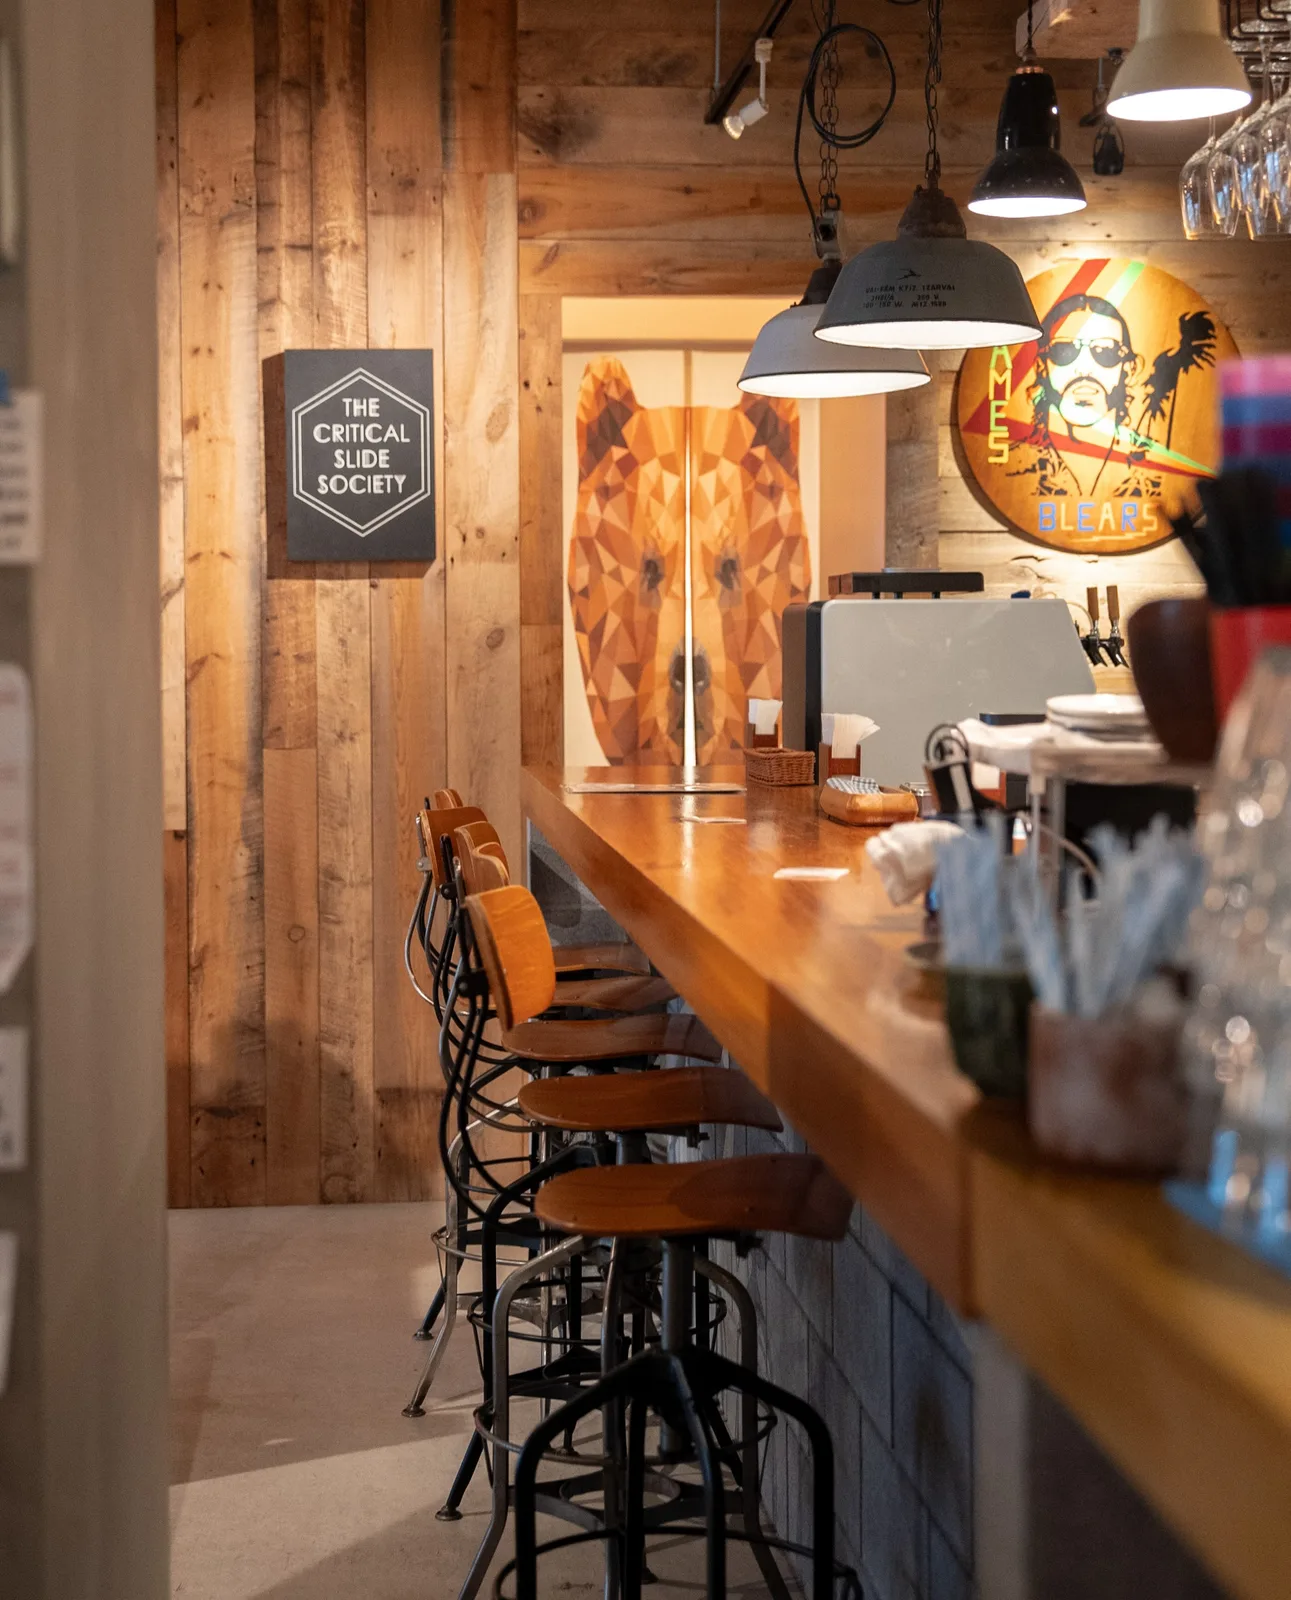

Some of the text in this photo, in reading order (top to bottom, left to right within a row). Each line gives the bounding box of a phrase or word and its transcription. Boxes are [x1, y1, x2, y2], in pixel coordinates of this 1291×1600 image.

[342, 397, 380, 418] THE
[313, 423, 411, 444] CRITICAL
[333, 449, 390, 469] SLIDE
[317, 474, 407, 495] SOCIETY
[1039, 502, 1159, 532] BLEARS
